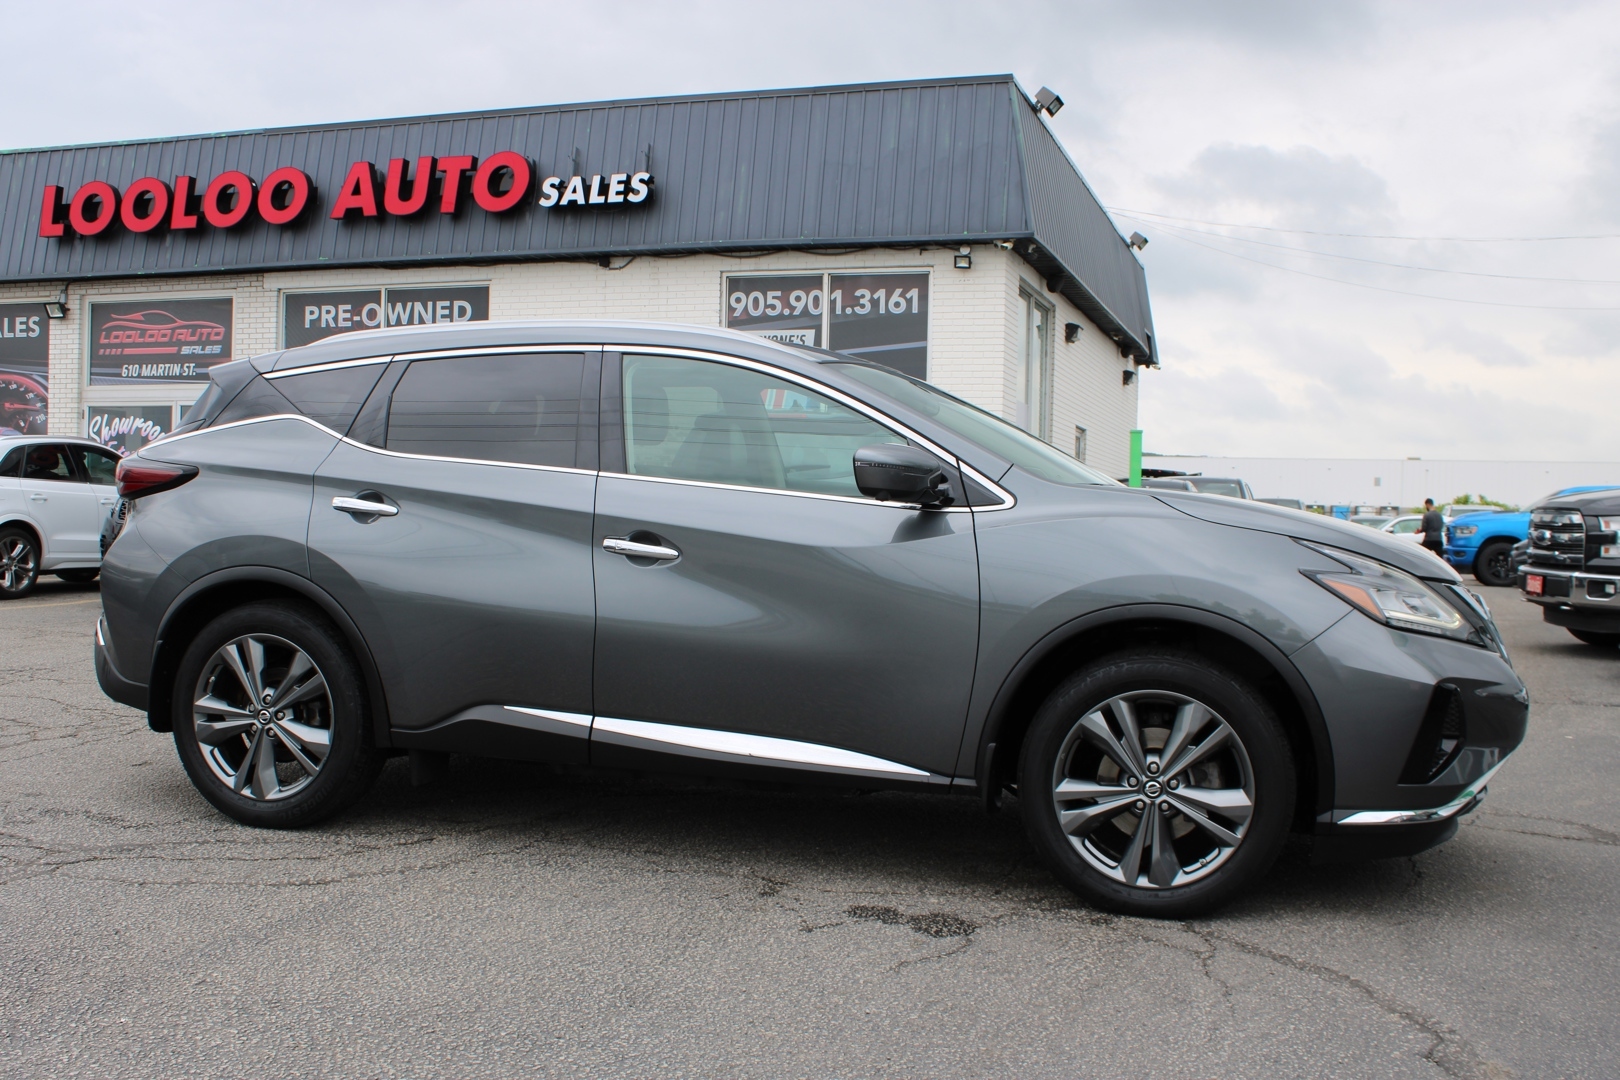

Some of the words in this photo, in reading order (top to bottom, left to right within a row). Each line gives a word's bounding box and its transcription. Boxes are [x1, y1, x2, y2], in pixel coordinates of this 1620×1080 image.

[39, 166, 310, 238] LOOLOO
[330, 151, 531, 220] AUTO
[538, 172, 651, 208] SALES
[729, 288, 919, 317] 905.901.3161
[304, 301, 473, 328] PRE-OWNED
[0, 316, 40, 338] LES
[99, 329, 172, 344] LOOLOO
[172, 328, 225, 342] AUTO
[180, 345, 222, 355] SALES
[121, 364, 140, 377] 610
[141, 363, 181, 377] MARTIN
[182, 363, 197, 376] ST.
